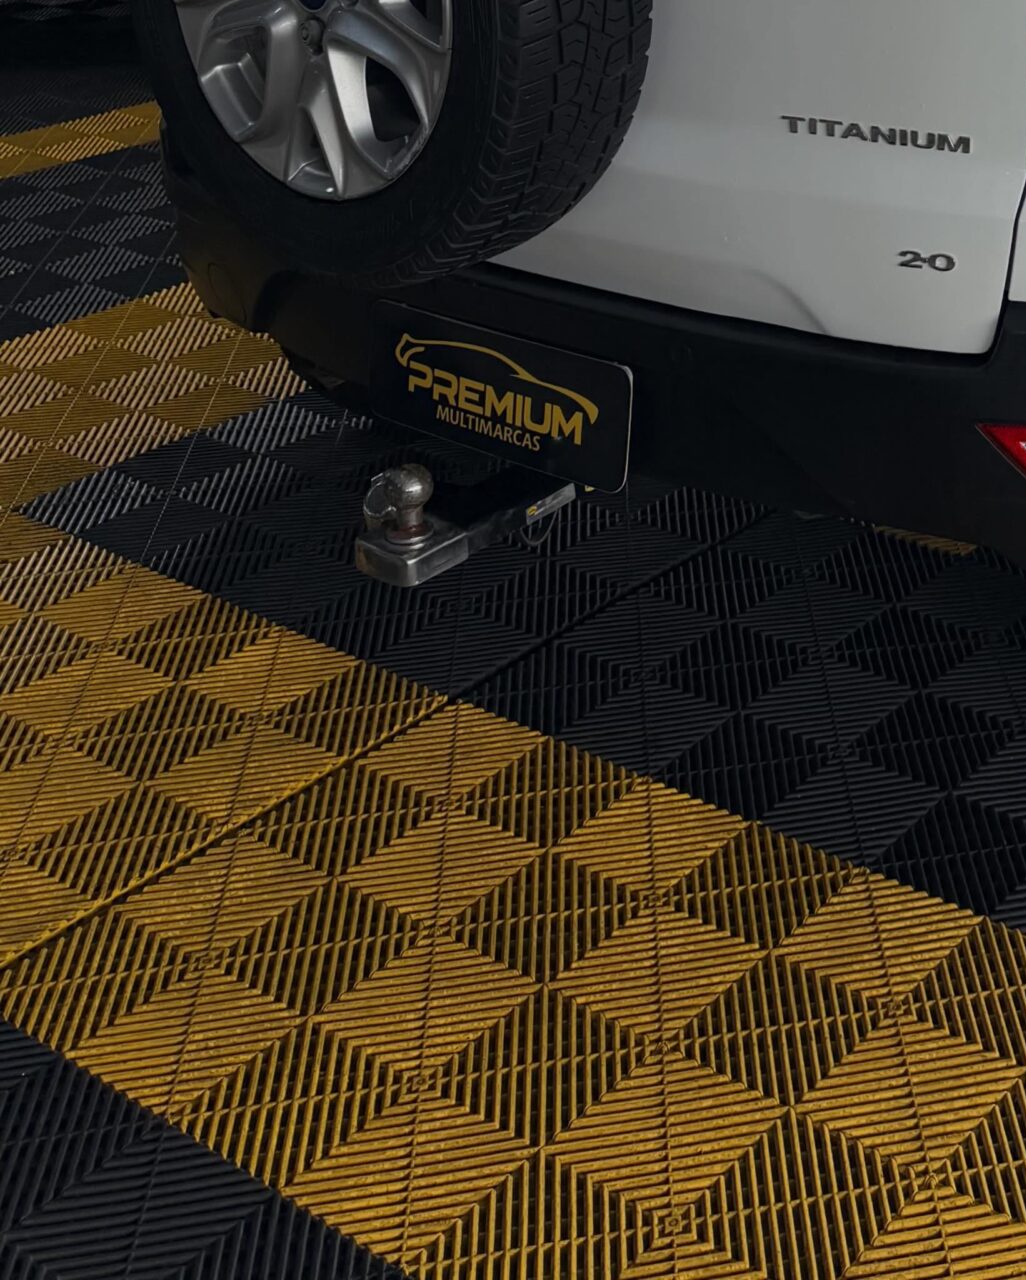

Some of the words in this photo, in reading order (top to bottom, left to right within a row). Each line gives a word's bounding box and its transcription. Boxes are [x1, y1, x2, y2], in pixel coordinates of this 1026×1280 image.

[780, 115, 971, 154] TITANIUM
[408, 360, 584, 446] PREMIUM
[436, 404, 541, 452] MULTIMARCAS
